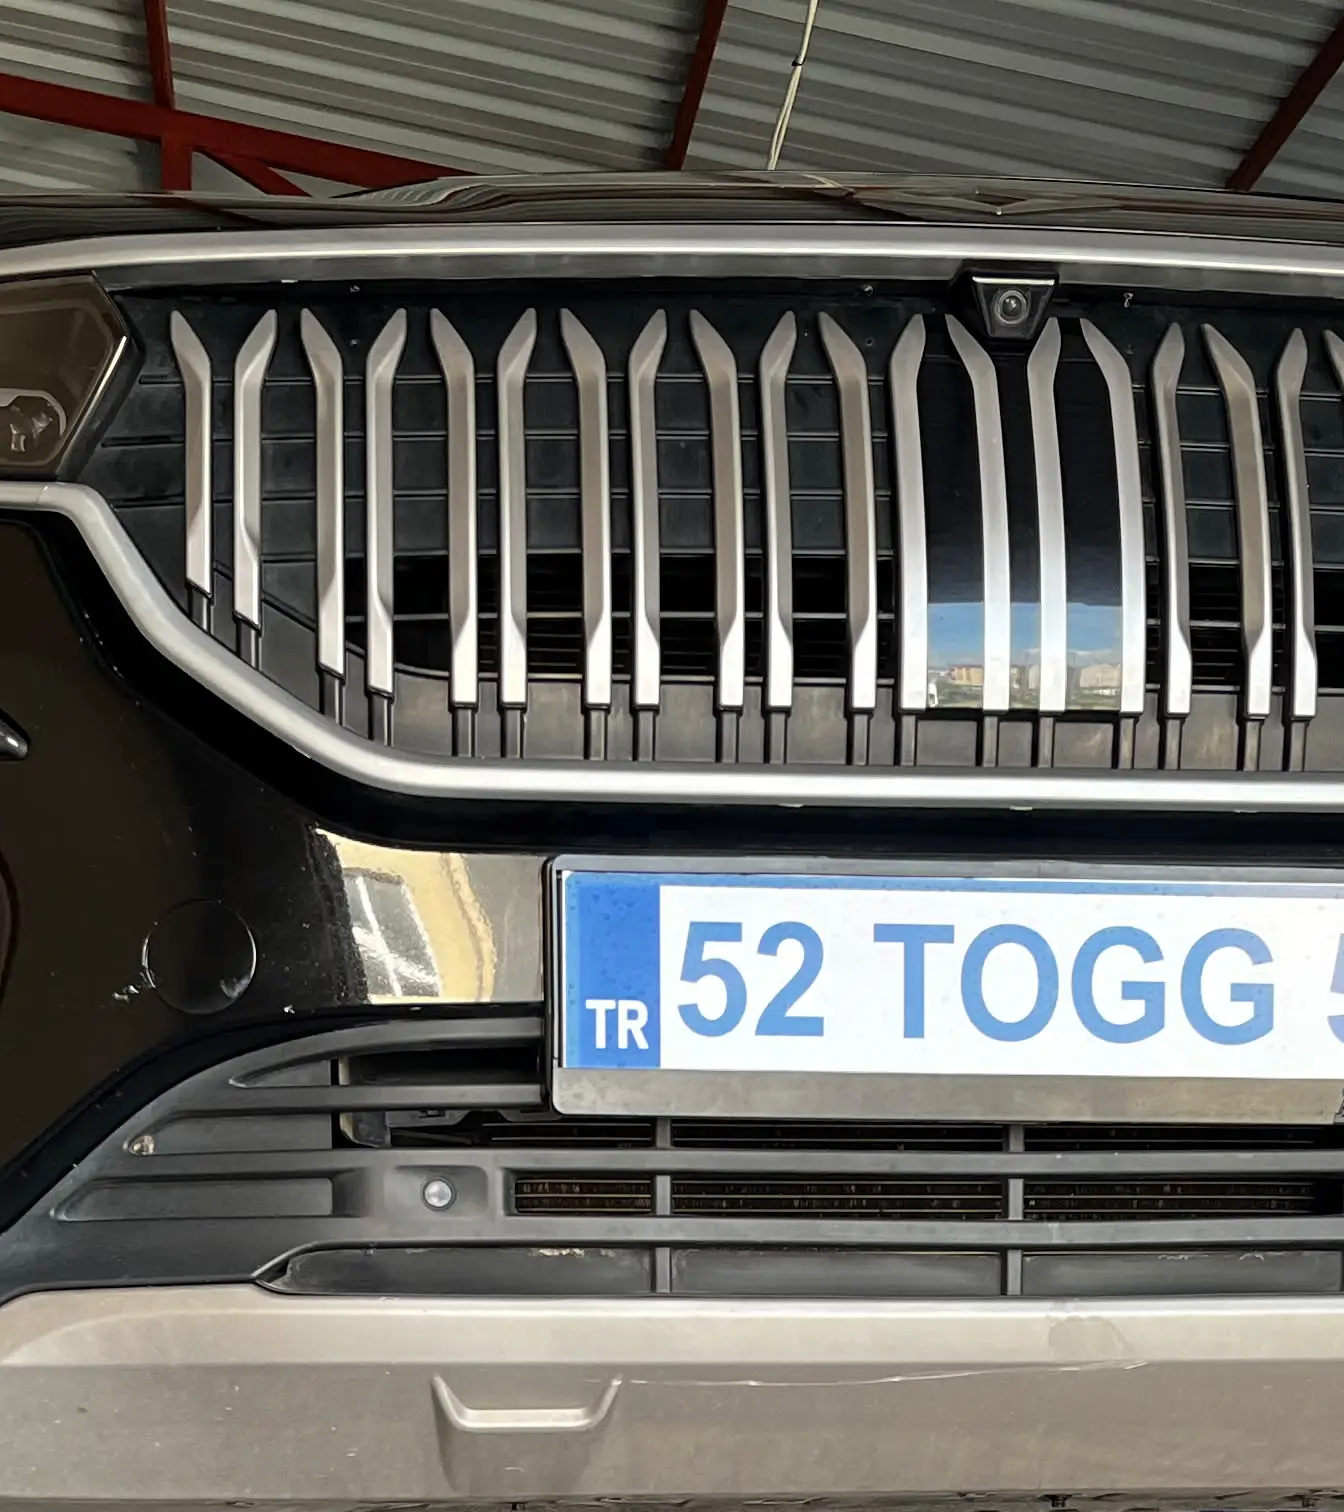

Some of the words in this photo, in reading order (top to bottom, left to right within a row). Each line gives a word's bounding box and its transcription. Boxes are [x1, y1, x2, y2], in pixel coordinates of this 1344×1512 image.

[585, 997, 650, 1051] TR
[677, 920, 826, 1038] 52
[872, 922, 1277, 1047] TOGG
